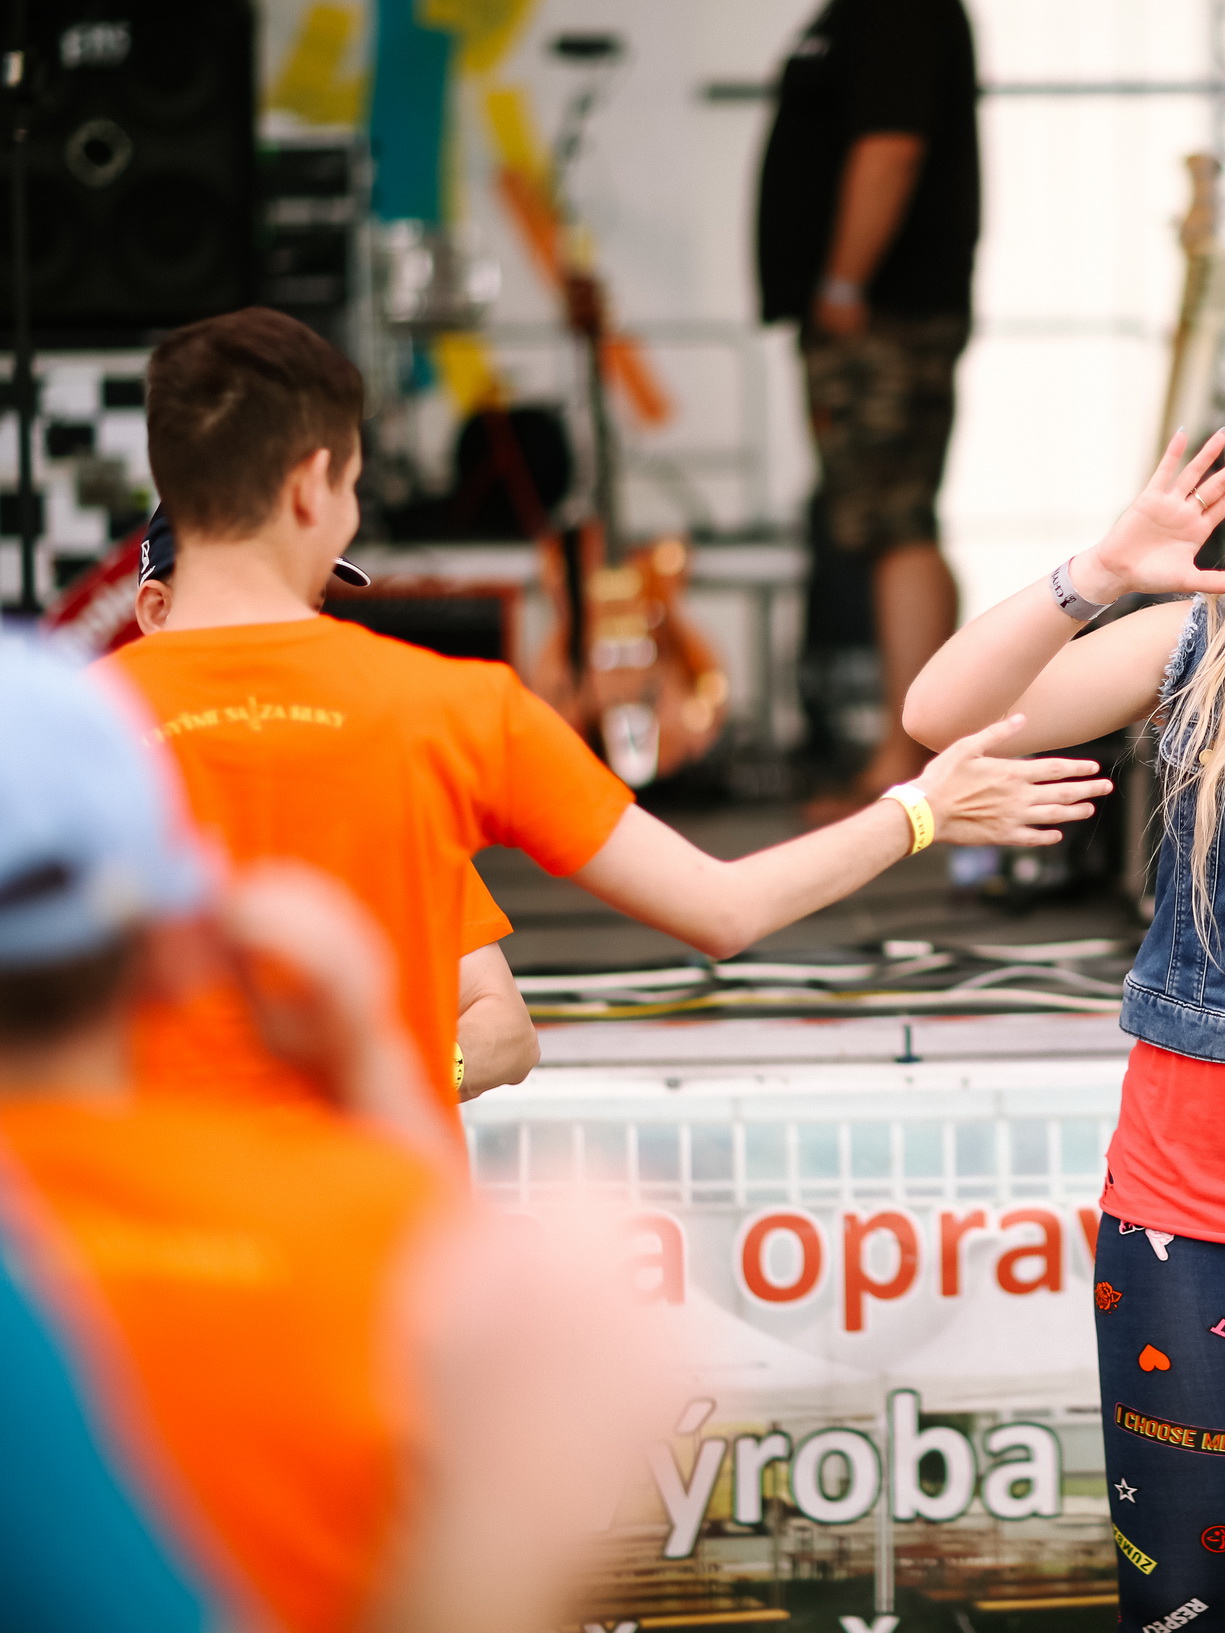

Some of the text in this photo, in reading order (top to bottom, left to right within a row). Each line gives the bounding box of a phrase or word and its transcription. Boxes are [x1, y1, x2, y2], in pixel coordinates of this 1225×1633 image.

[742, 1208, 1101, 1332] opra
[650, 1388, 1064, 1560] ýroba
[1116, 1406, 1122, 1423] I
[1124, 1411, 1198, 1448] CHOOSE
